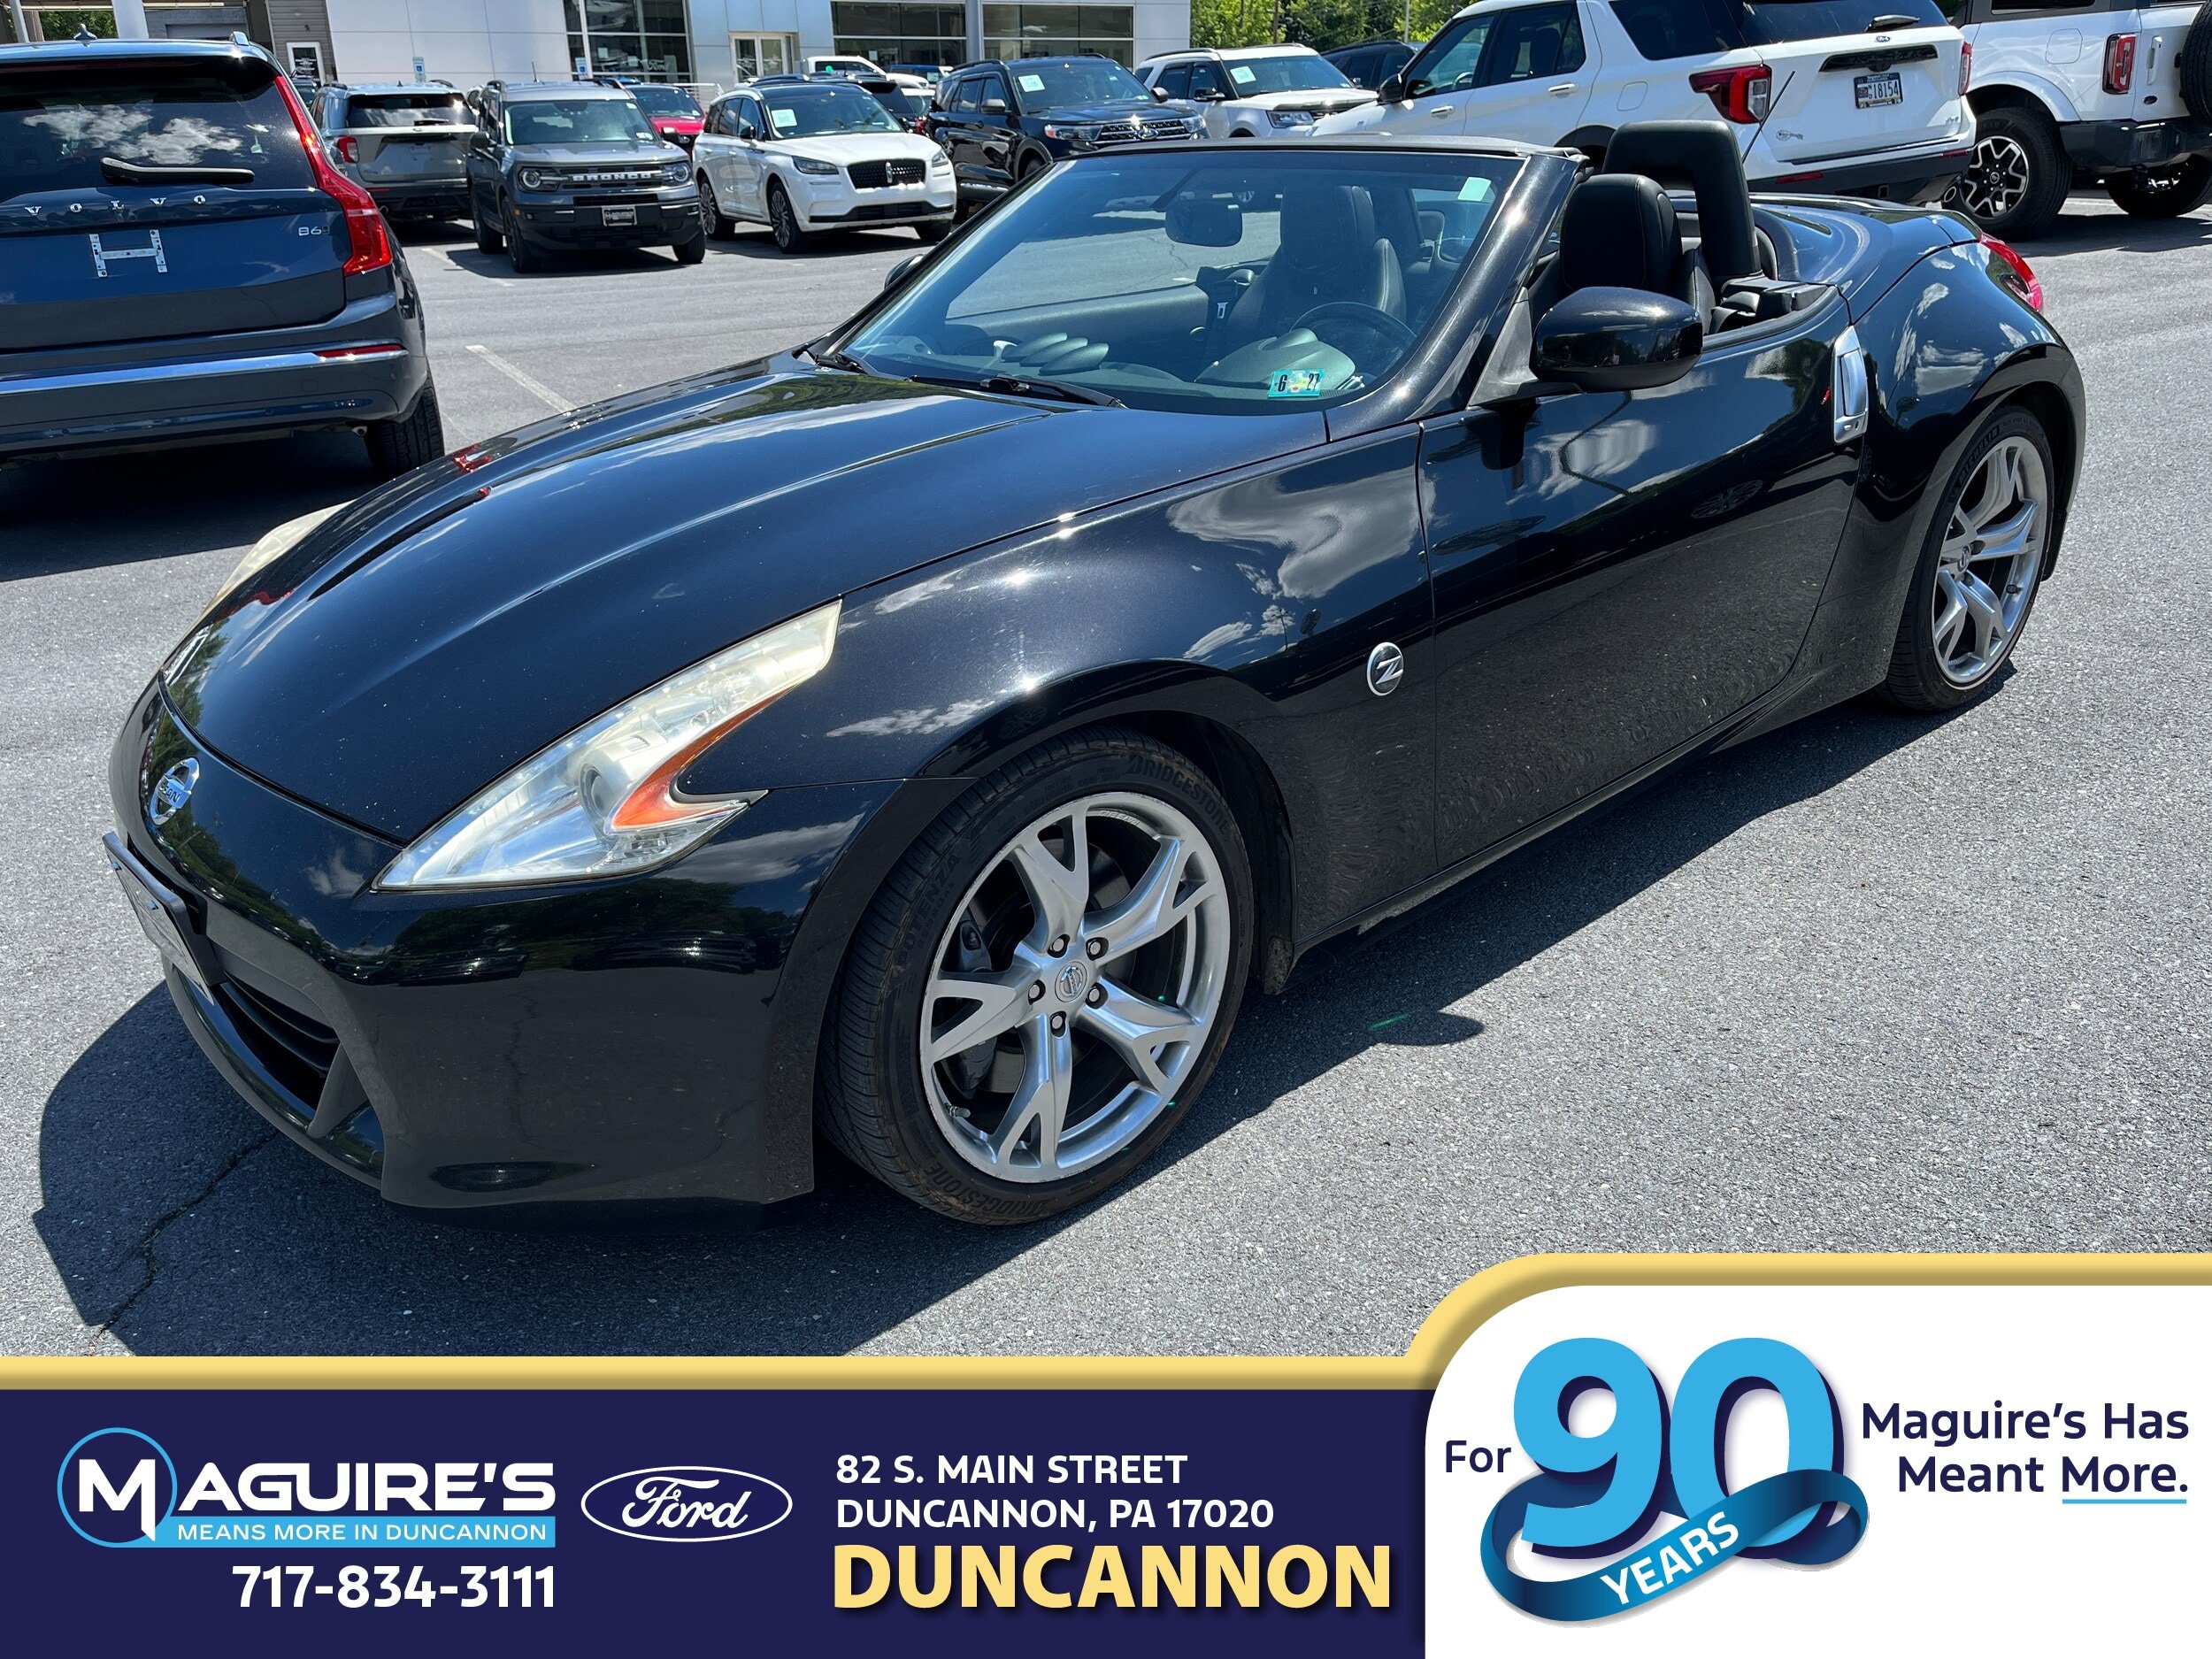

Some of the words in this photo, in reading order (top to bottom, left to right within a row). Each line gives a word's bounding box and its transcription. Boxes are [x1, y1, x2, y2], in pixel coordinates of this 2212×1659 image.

[1873, 81, 1899, 99] 18154
[572, 172, 652, 182] BRONCO
[25, 194, 207, 216] VOLVO
[1277, 374, 1288, 392] 6
[1306, 373, 1320, 391] 27
[1125, 753, 1230, 835] BRIDGESTONE
[894, 855, 963, 968] POTENZA
[923, 1162, 1050, 1215] BRIDGESTONE
